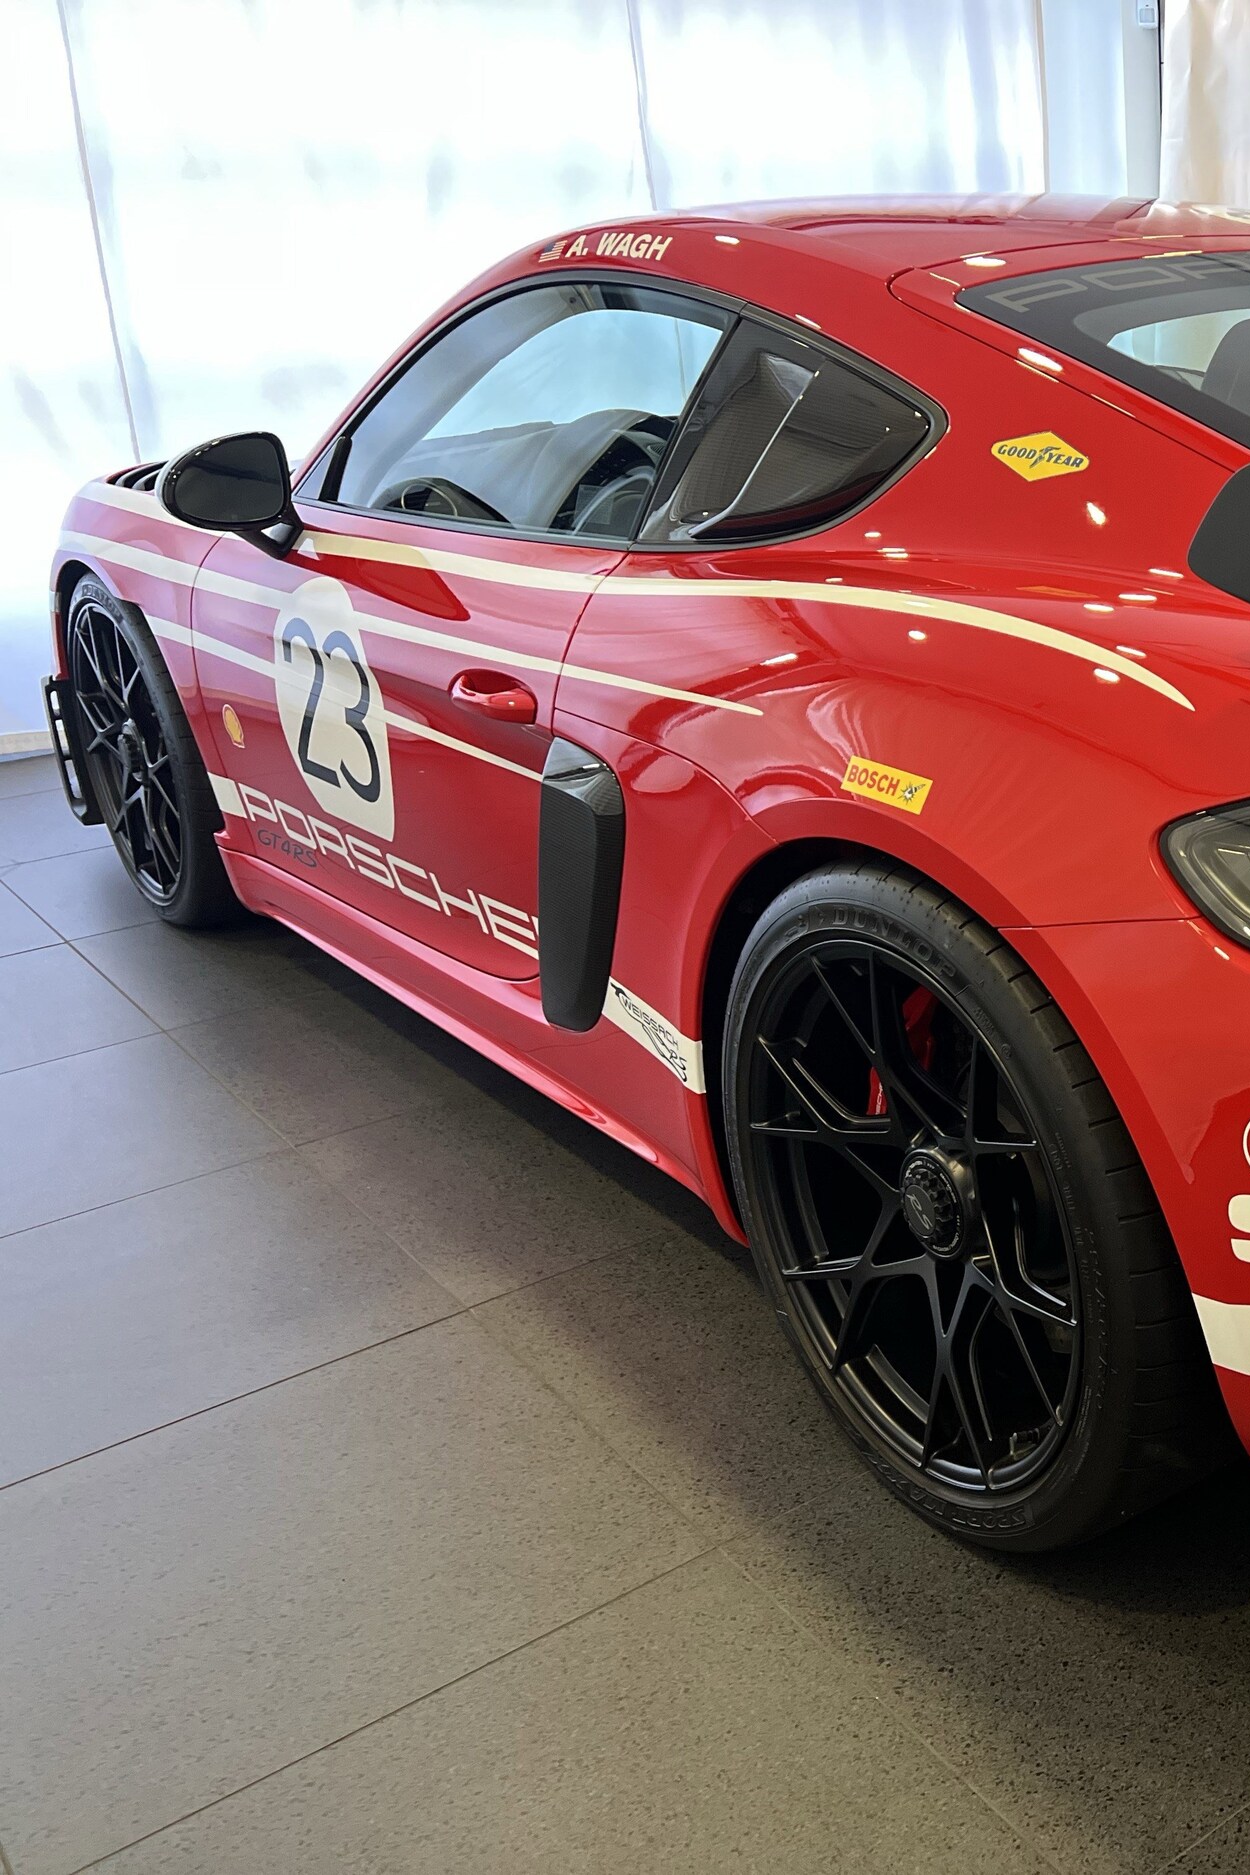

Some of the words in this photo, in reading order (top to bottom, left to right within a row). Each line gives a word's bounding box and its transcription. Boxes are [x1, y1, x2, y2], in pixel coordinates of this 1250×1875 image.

[565, 234, 589, 258] A.
[596, 232, 673, 261] WAGH
[282, 616, 381, 803] 23
[847, 764, 901, 797] BOSCH
[257, 828, 318, 869] GT4RS
[238, 782, 540, 961] PORSCHE
